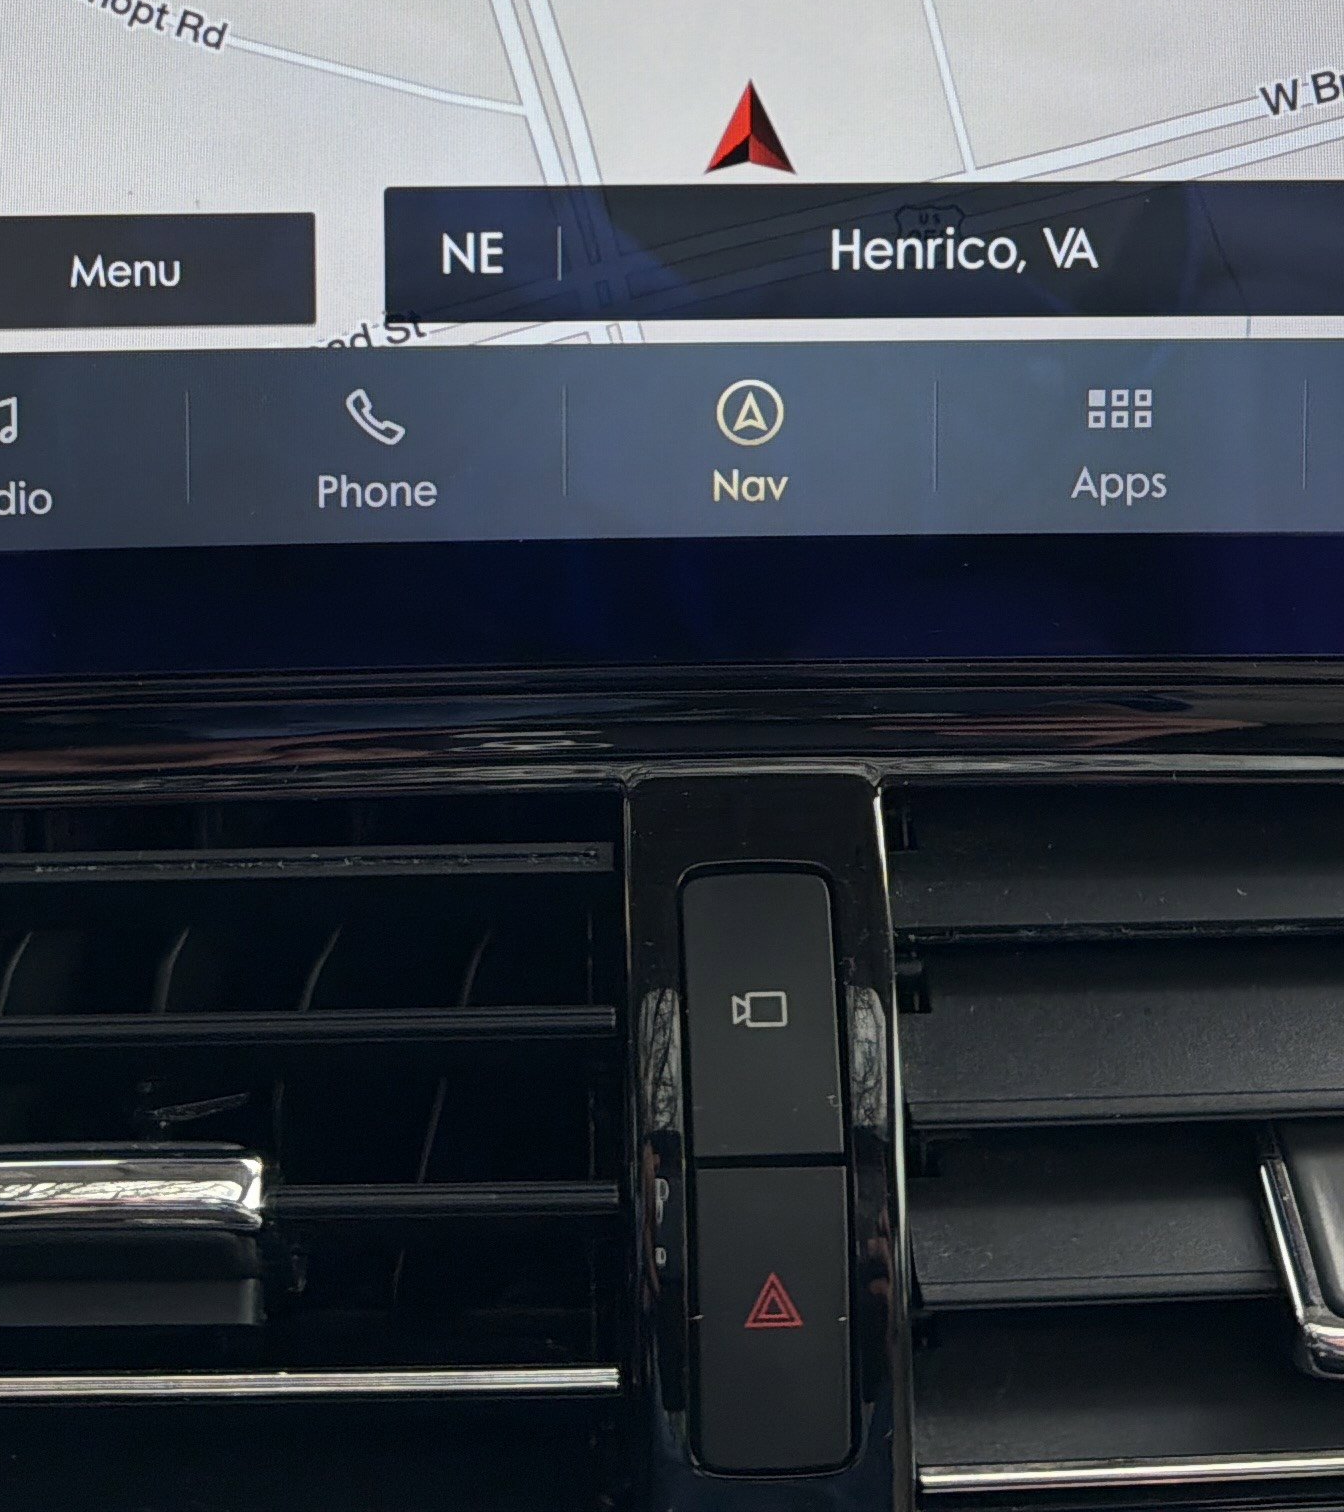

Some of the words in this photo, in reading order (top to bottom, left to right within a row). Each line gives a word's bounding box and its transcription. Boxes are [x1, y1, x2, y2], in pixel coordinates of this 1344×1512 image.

[174, 9, 229, 50] Rd
[1259, 78, 1299, 116] W
[443, 232, 503, 274] NE
[832, 227, 1026, 273] Henrico,
[1043, 228, 1099, 268] VA
[71, 255, 180, 287] Menu
[319, 475, 437, 508] Phone
[714, 469, 788, 501] Nav
[1071, 467, 1166, 506] Apps
